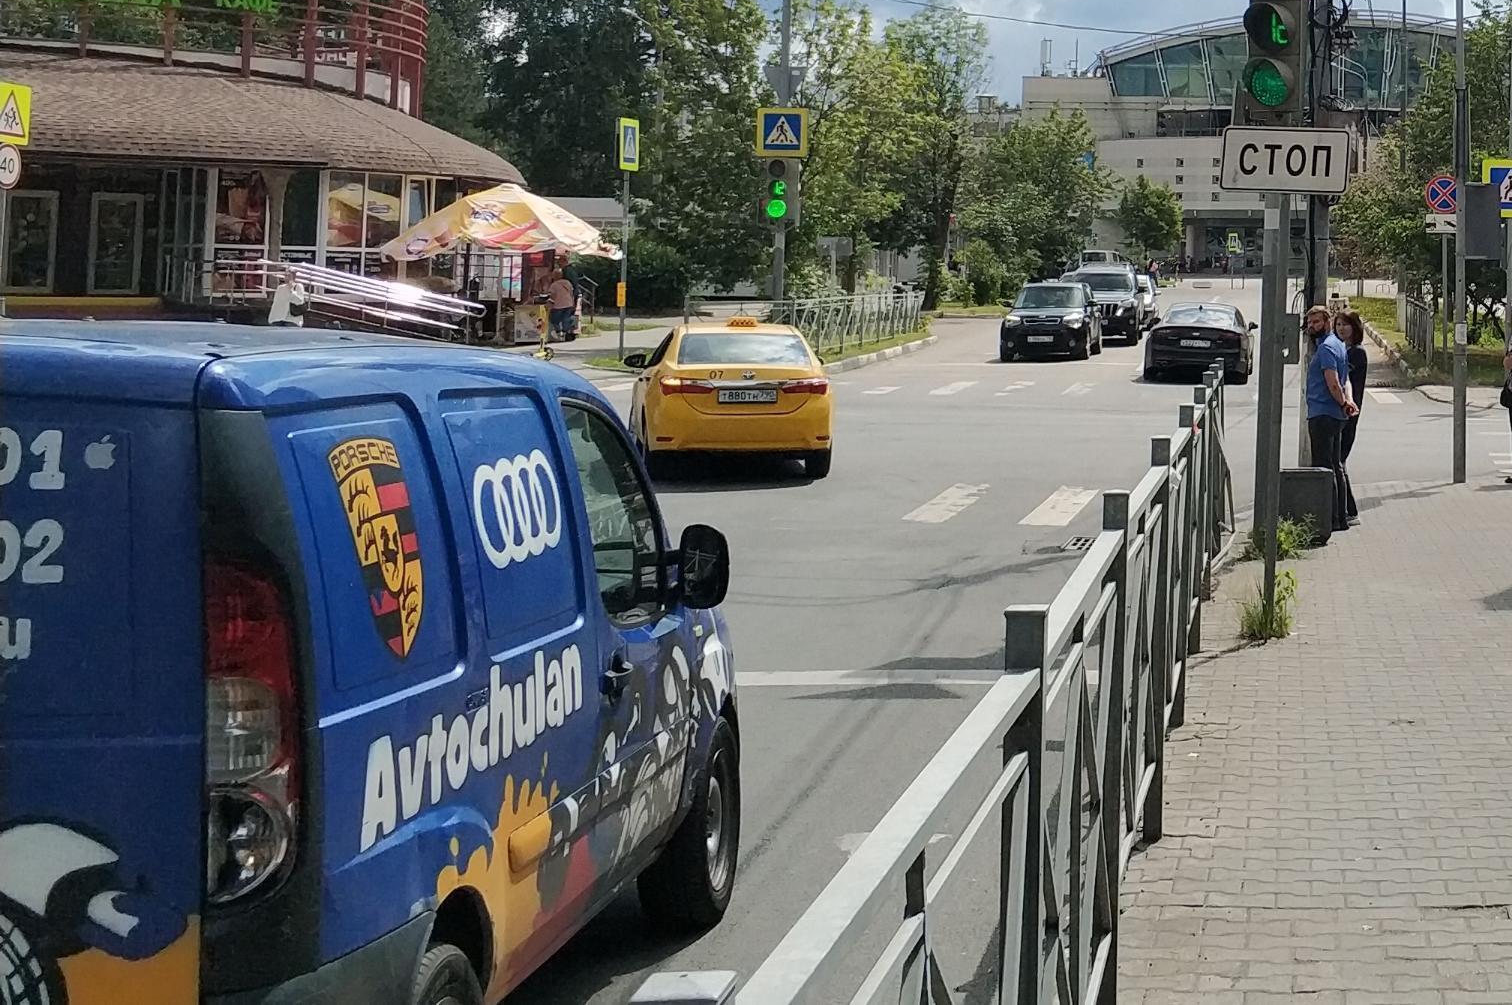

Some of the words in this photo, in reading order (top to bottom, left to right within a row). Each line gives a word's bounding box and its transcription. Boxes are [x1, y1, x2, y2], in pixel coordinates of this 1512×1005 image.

[0, 157, 15, 174] 40
[1239, 143, 1332, 177] СТОП
[709, 370, 724, 380] 07
[331, 444, 398, 475] PORSCHE
[360, 644, 583, 853] Avtochulan
